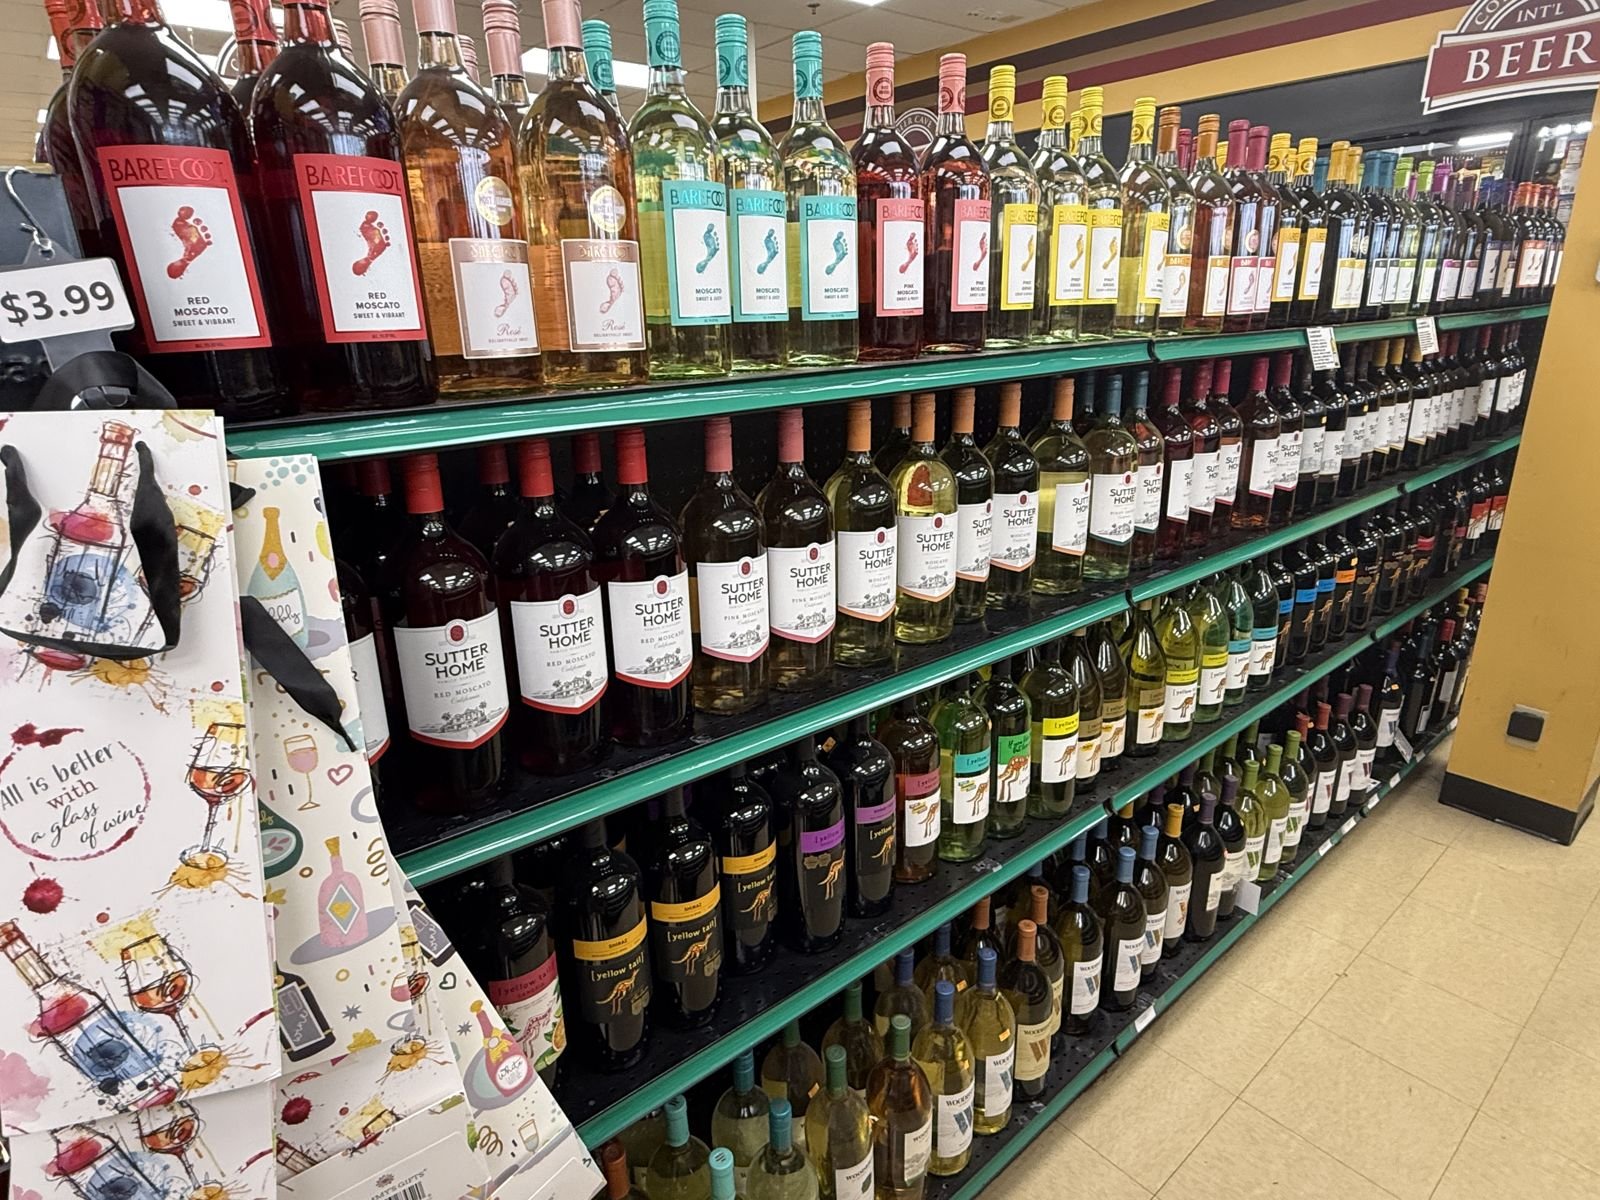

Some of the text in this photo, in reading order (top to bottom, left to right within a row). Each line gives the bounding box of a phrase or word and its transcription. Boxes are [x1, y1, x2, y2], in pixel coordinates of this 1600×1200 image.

[1516, 2, 1565, 23] INT'L
[1462, 30, 1599, 84] BEER
[108, 157, 226, 183] BAREFOOT
[306, 164, 400, 191] BAREFOOT
[187, 296, 210, 305] RED
[367, 291, 386, 300] RED
[1, 281, 116, 327] $3.99
[173, 305, 229, 316] MOSCATO
[355, 301, 401, 310] MOSCATO
[172, 317, 196, 327] SWEET
[204, 316, 236, 325] VIBRANT
[352, 312, 373, 320] SWEET
[380, 311, 406, 319] VIBRANT
[496, 323, 523, 337] Rosé
[1003, 508, 1036, 518] SUTTER
[1008, 517, 1033, 526] HOME
[917, 531, 954, 543] SUTTER
[859, 546, 895, 560] SUTTER
[922, 541, 951, 552] HOME
[790, 563, 831, 578] SUTTER
[865, 556, 893, 569] HOME
[721, 577, 764, 594] SUTTER
[796, 574, 828, 588] HOME
[728, 589, 762, 605] HOME
[635, 596, 684, 616] SUTTER
[643, 609, 681, 627] HOME
[539, 616, 595, 637] SUTTER
[549, 631, 592, 649] HOME
[658, 629, 685, 642] MOSCATO
[425, 643, 489, 666] SUTTER
[565, 651, 596, 665] MOSCATO
[435, 657, 485, 679] HOME
[433, 680, 492, 699] RED MOSCATO
[0, 742, 113, 811] All is better
[46, 778, 99, 811] with
[30, 802, 100, 848] a glass
[79, 803, 146, 849] of wine
